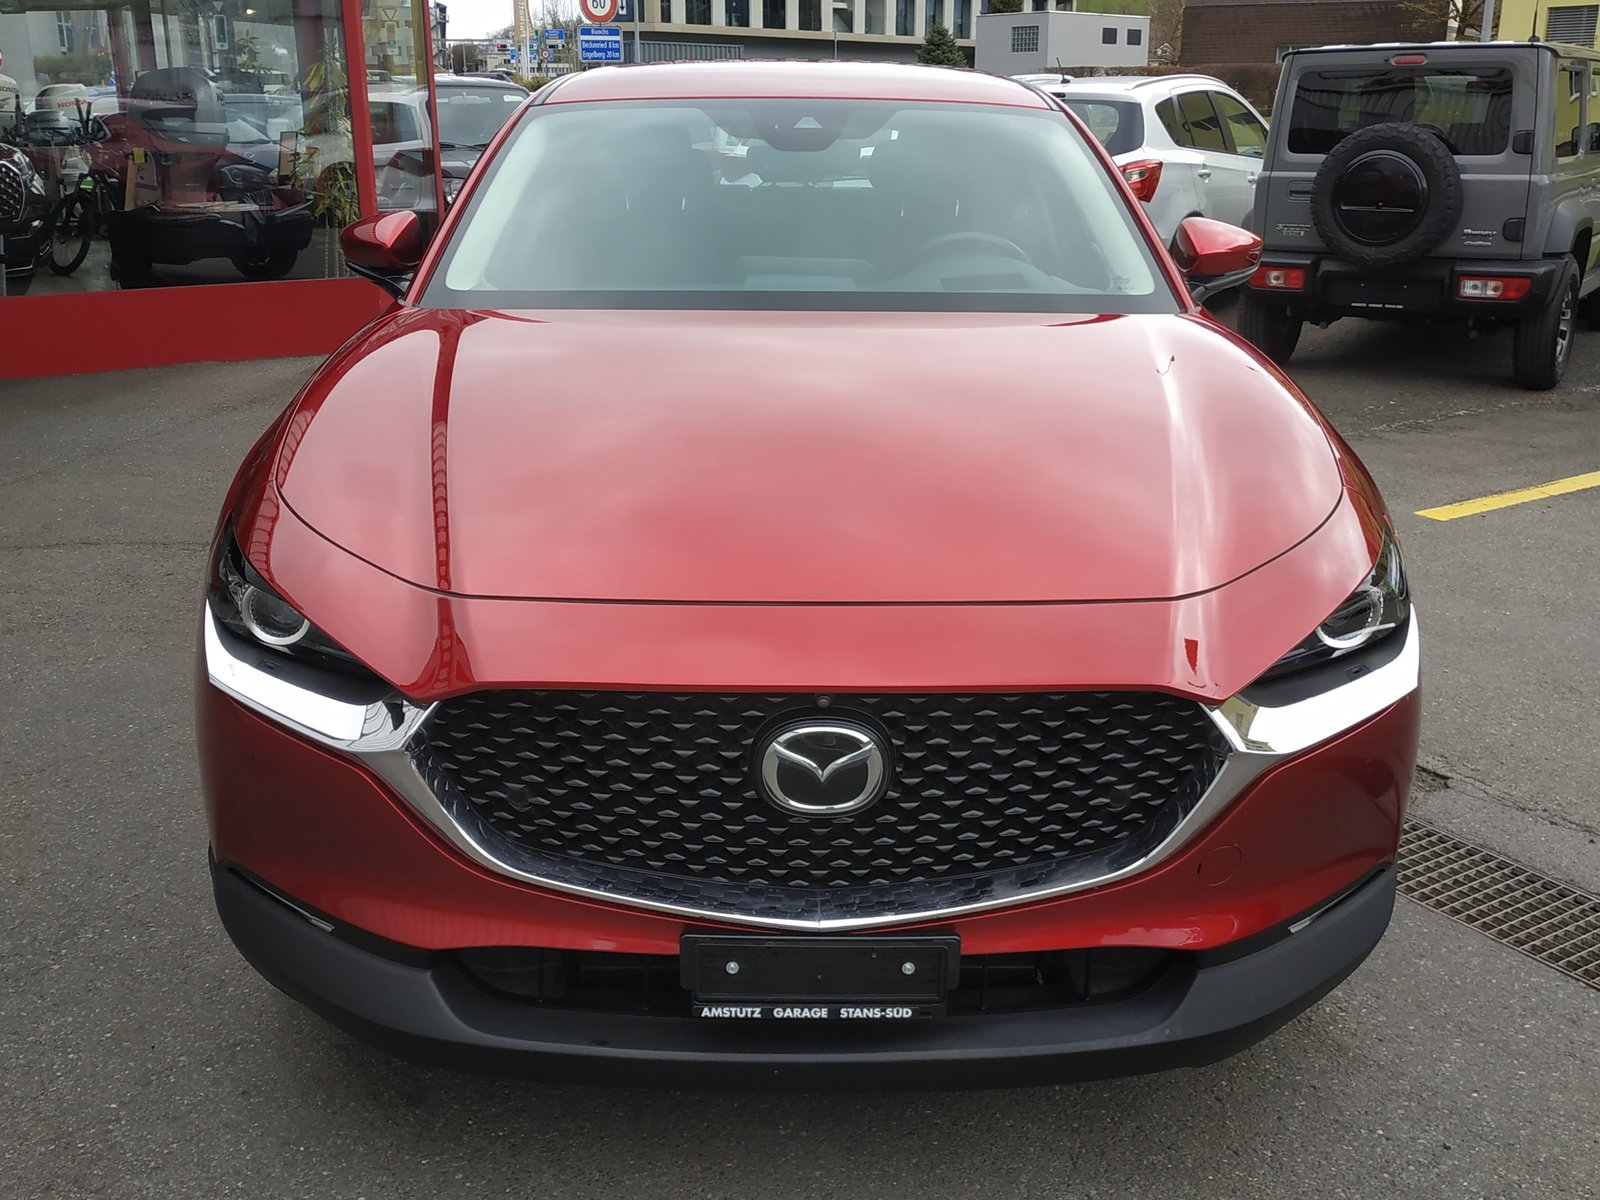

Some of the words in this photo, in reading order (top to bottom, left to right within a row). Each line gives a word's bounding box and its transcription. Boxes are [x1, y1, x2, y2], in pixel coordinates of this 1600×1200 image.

[582, 41, 607, 49] Beckenried
[613, 41, 620, 49] km
[582, 51, 606, 59] Engelberg
[701, 1007, 762, 1018] AMSTUTZ
[773, 1007, 829, 1018] GARAGE
[840, 1006, 912, 1018] STANS-SÜD
